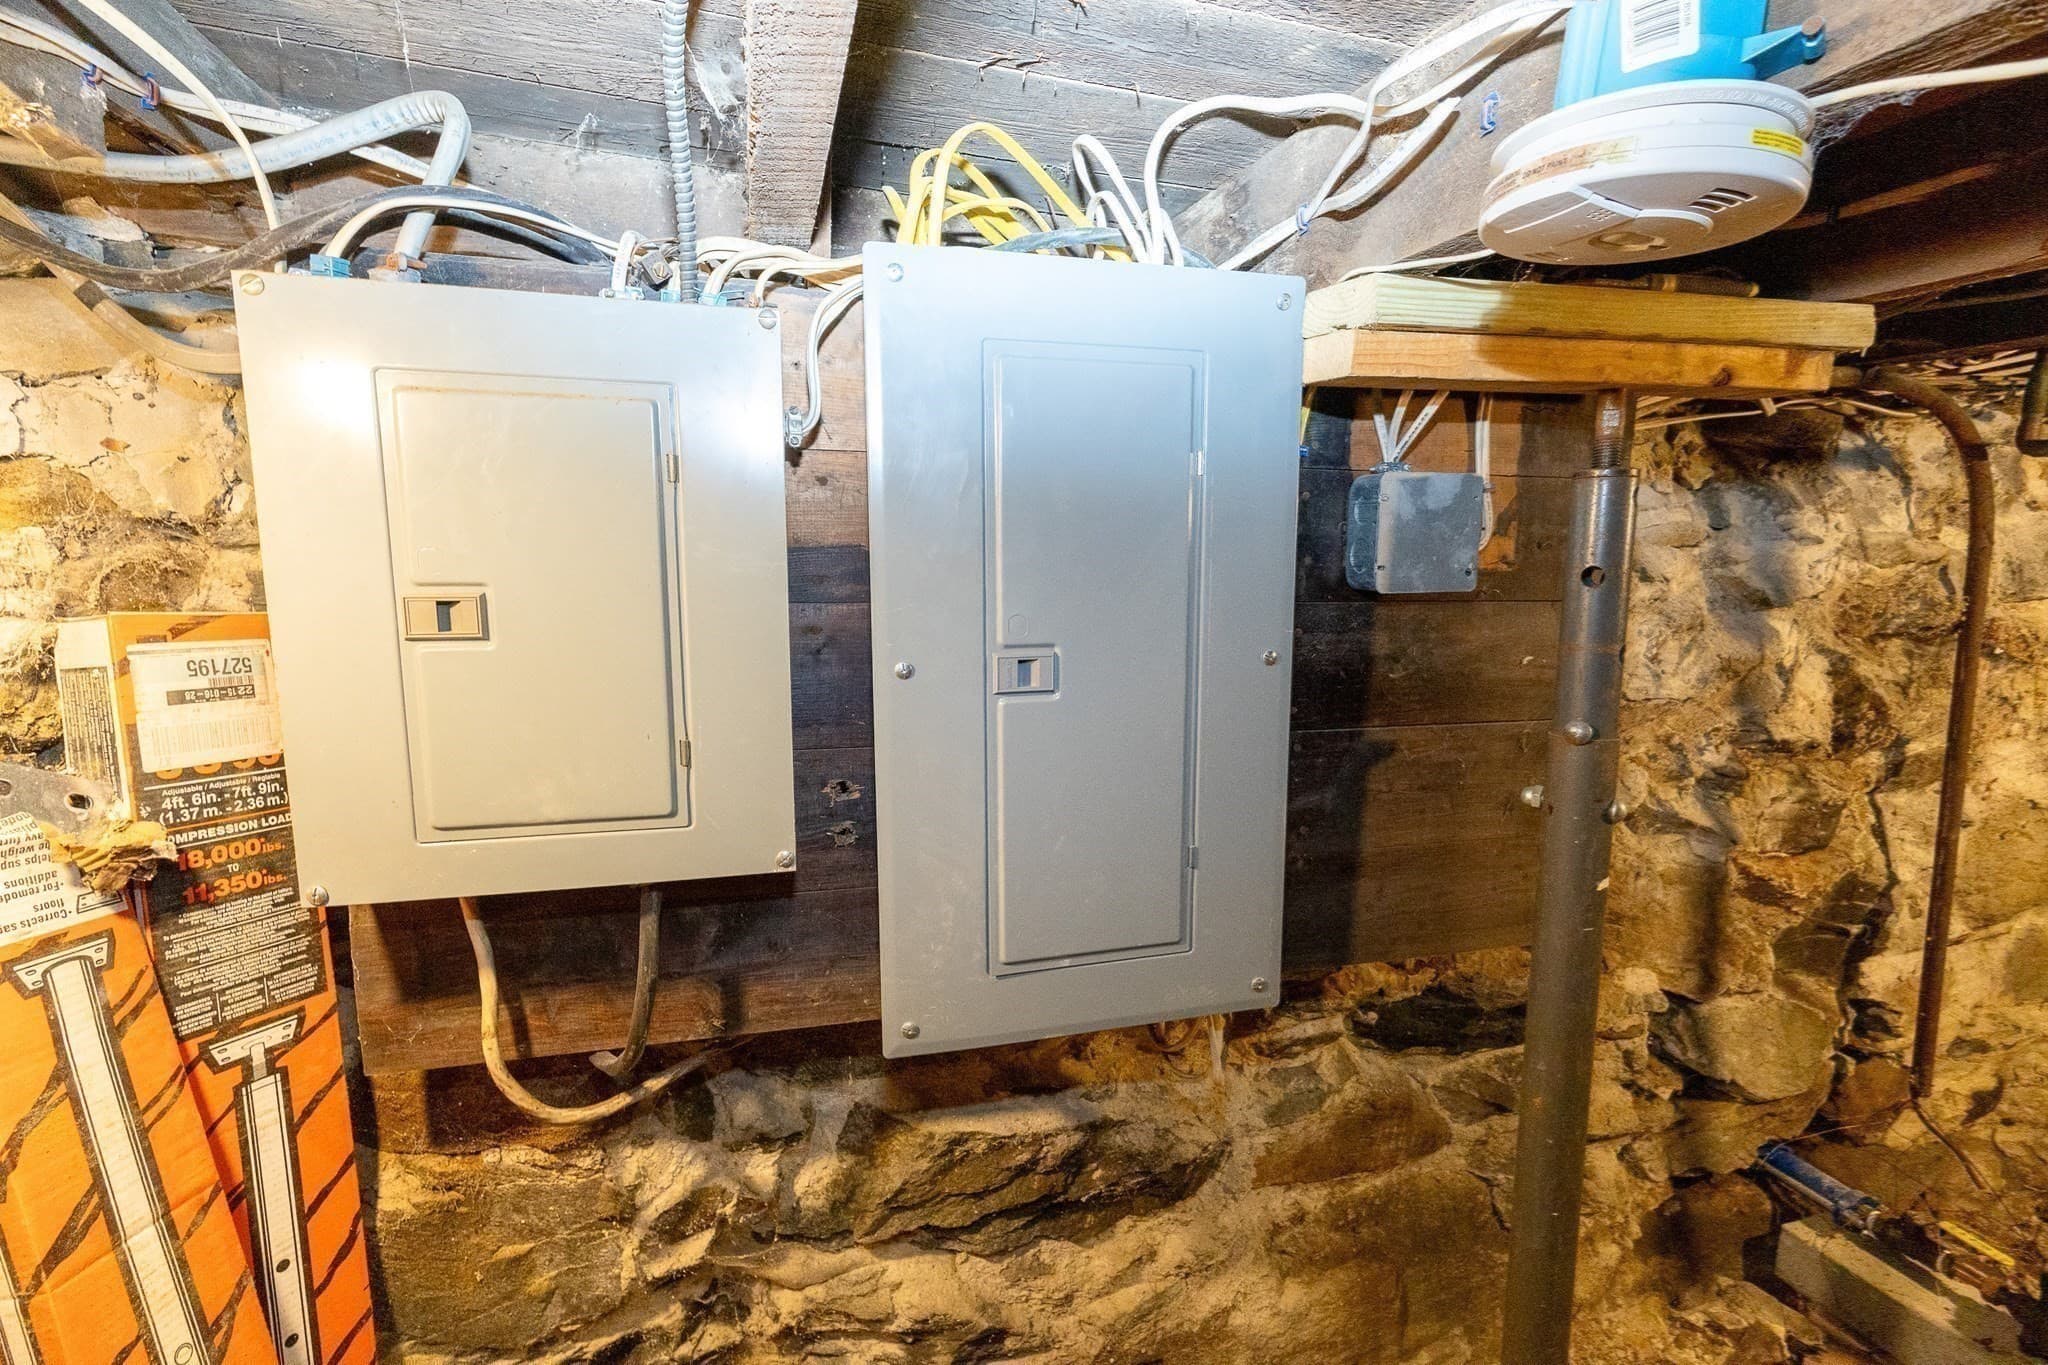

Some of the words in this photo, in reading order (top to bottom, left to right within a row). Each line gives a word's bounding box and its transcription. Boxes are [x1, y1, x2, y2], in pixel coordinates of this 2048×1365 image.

[186, 657, 253, 677] 527195
[161, 784, 203, 797] Adjustable
[209, 777, 248, 790] Adjustable
[161, 797, 189, 811] 4ft.
[191, 791, 222, 807] 6in.
[232, 785, 257, 800] 7ft.
[258, 781, 285, 795] 9in.
[159, 807, 198, 827] (1.37
[202, 805, 223, 818] m.
[234, 796, 265, 812] 2.36
[266, 791, 289, 807] m.)
[167, 820, 259, 845] OMPRESSION
[227, 863, 240, 873] TO
[4, 870, 58, 889] additions
[43, 881, 61, 892] For
[32, 898, 65, 913] floors
[20, 909, 68, 927] Corrects
